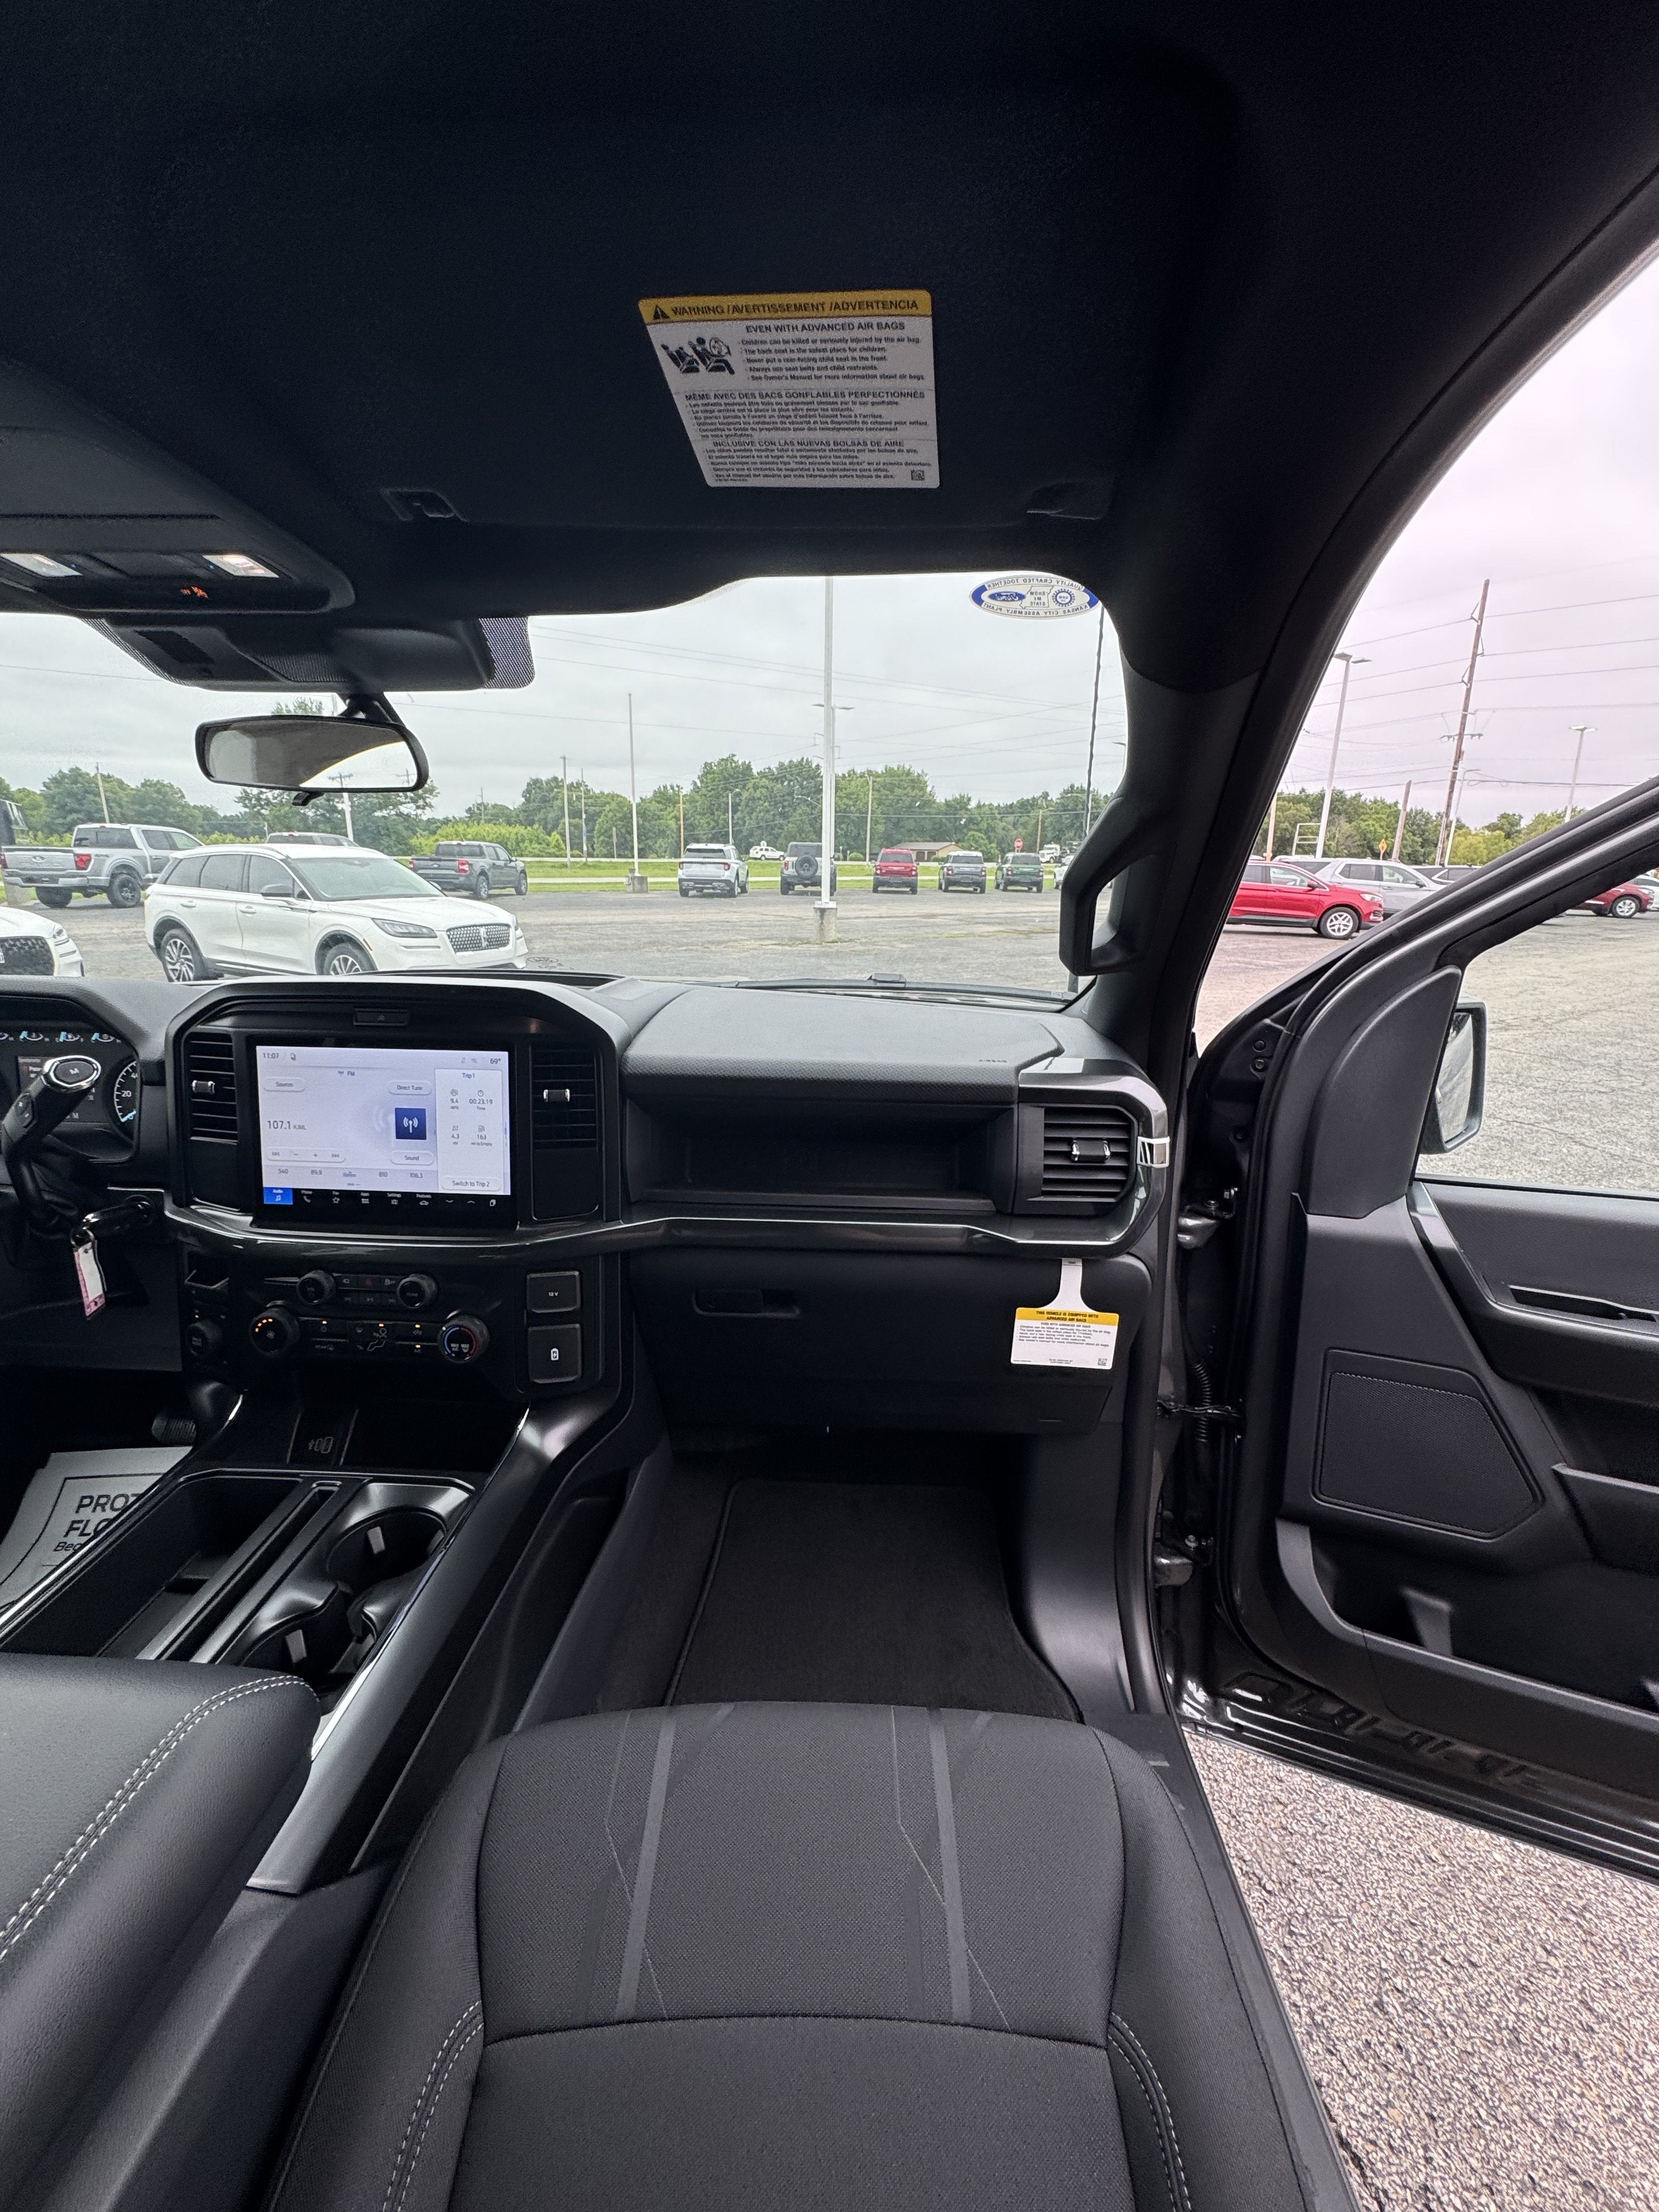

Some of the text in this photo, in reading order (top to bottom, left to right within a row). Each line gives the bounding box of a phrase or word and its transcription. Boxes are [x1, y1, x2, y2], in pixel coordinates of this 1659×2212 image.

[671, 304, 724, 316] WARNING
[801, 322, 854, 332] ADVANCED
[877, 321, 905, 330] BAGS
[267, 1120, 291, 1130] 107.1
[75, 1493, 142, 1514] PRO
